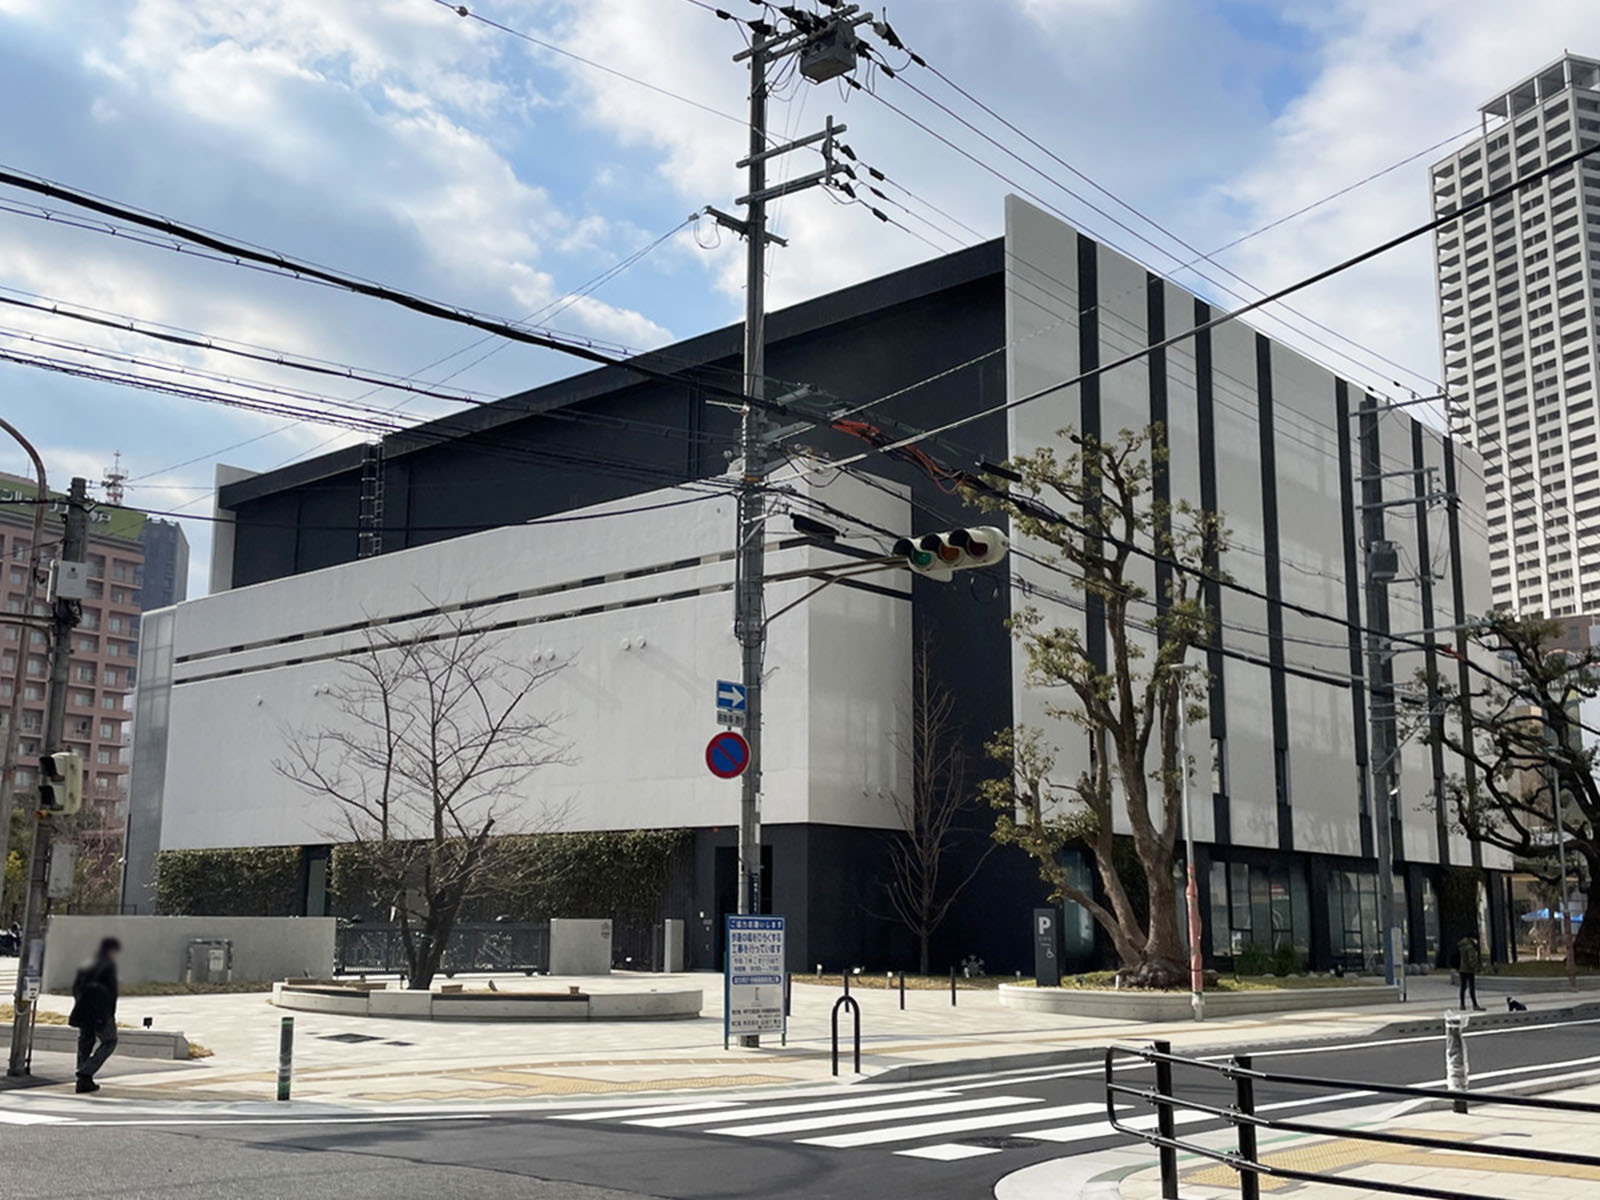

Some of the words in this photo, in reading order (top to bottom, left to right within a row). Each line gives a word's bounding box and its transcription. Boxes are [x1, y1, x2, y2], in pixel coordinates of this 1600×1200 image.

[1038, 916, 1051, 935] P
[731, 943, 781, 954] 工事を行っています
